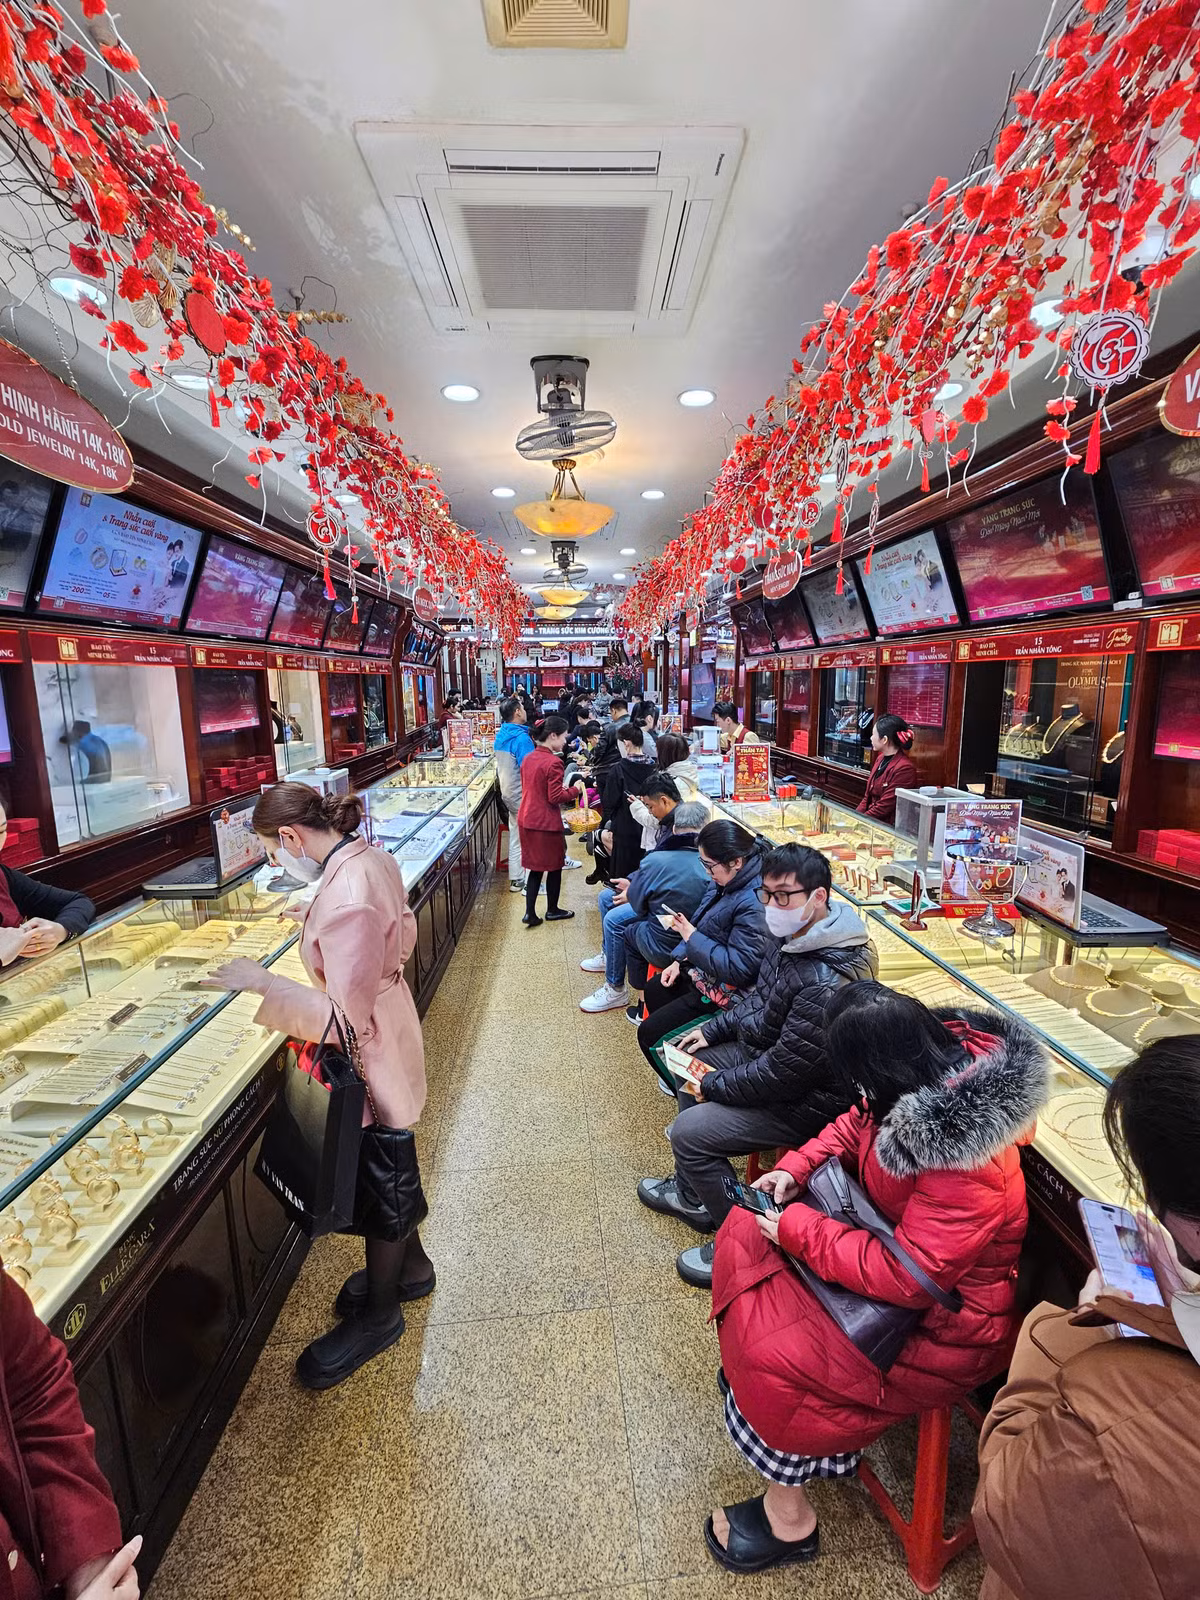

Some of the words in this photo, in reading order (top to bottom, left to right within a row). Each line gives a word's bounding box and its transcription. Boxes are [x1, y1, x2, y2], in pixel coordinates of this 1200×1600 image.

[27, 426, 76, 461] JEWELRY
[79, 453, 100, 475] 14K,
[101, 464, 119, 481] 18K
[1000, 503, 1020, 518] TRANG
[1021, 498, 1036, 510] SỨC
[109, 514, 129, 531] Trang
[72, 586, 85, 594] 200
[102, 591, 110, 599] 05
[539, 627, 560, 635] TRANG
[561, 626, 574, 635] SỨC
[574, 627, 587, 635] KIM
[587, 626, 609, 635] CƯƠNG
[1034, 637, 1043, 645] 15
[149, 646, 156, 655] 15
[1015, 646, 1029, 655] TRẦN
[1029, 646, 1045, 655] NHÂN
[1045, 645, 1062, 654] TÔNG
[147, 654, 160, 663] NHÂN
[172, 1155, 199, 1191] TRANG
[199, 1137, 214, 1160] SỨC
[223, 1098, 246, 1128] PHONG
[245, 1080, 261, 1102] CÁCH
[1037, 1163, 1064, 1194] CÁCH
